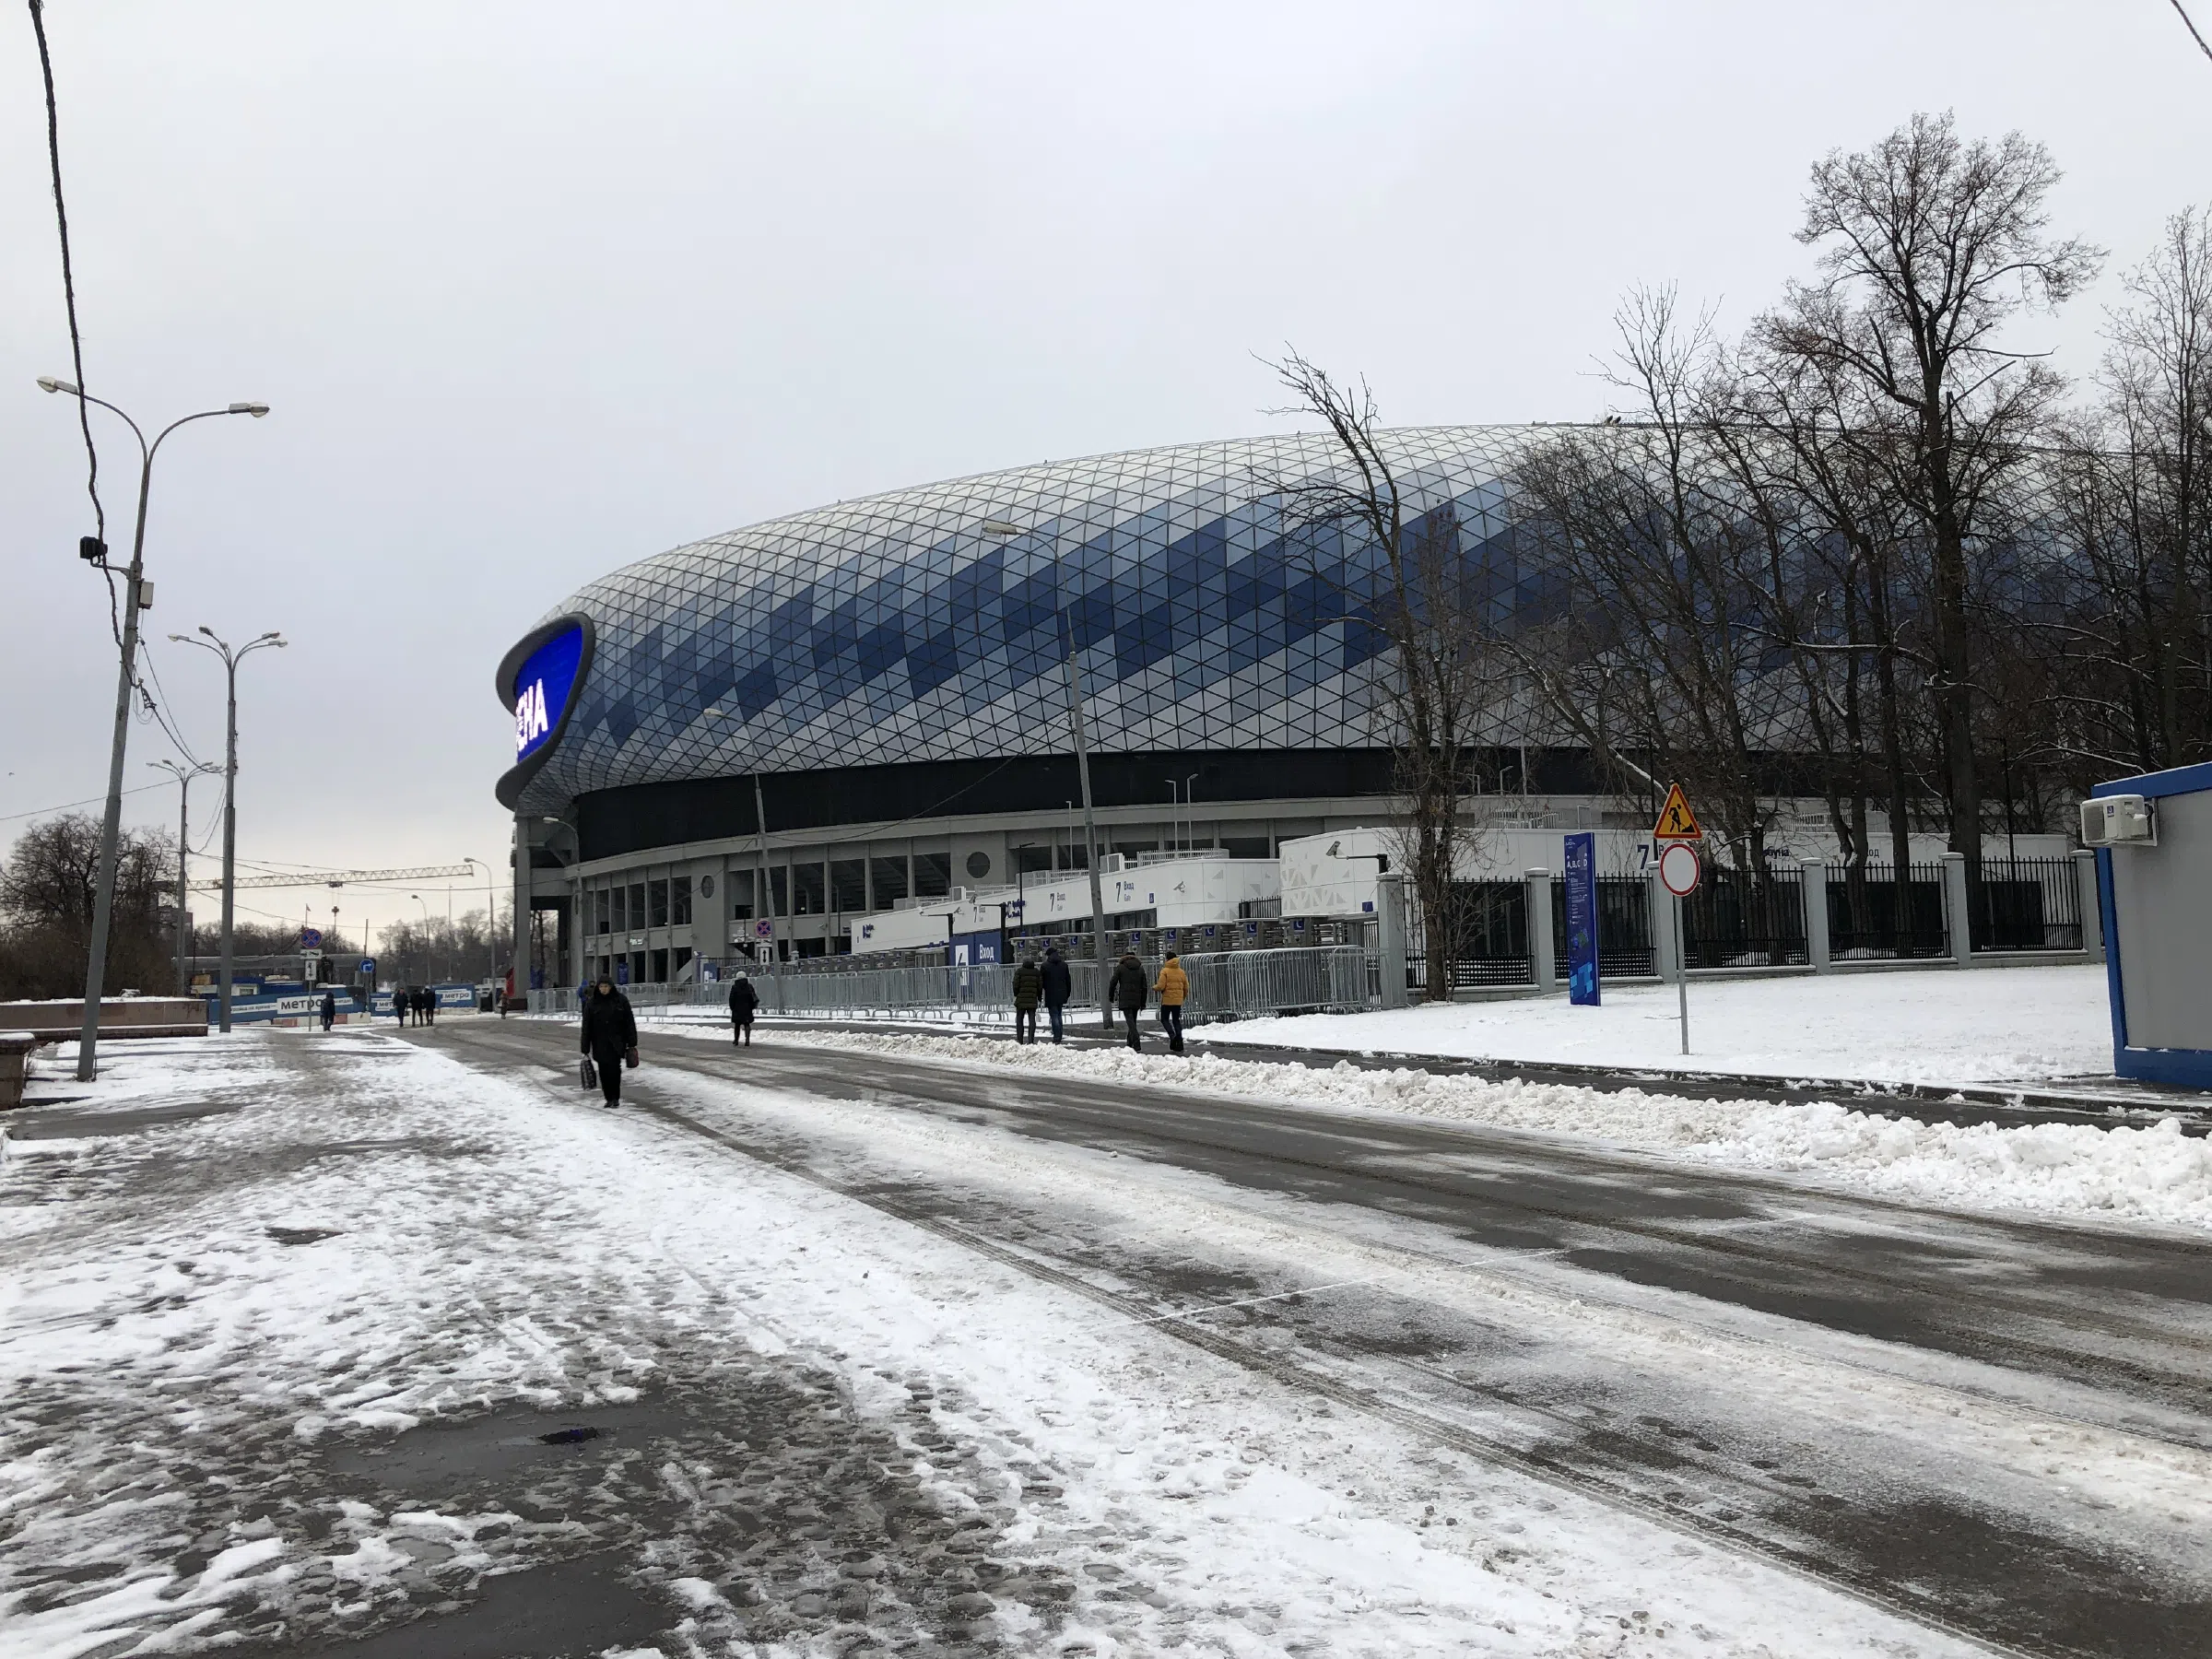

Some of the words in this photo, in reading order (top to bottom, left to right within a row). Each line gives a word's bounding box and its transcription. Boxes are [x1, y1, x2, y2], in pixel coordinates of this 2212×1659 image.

[1637, 844, 1650, 870] 7
[1116, 881, 1122, 902] 7
[979, 944, 994, 961] Вход
[280, 998, 323, 1011] метро
[444, 992, 470, 1001] метро
